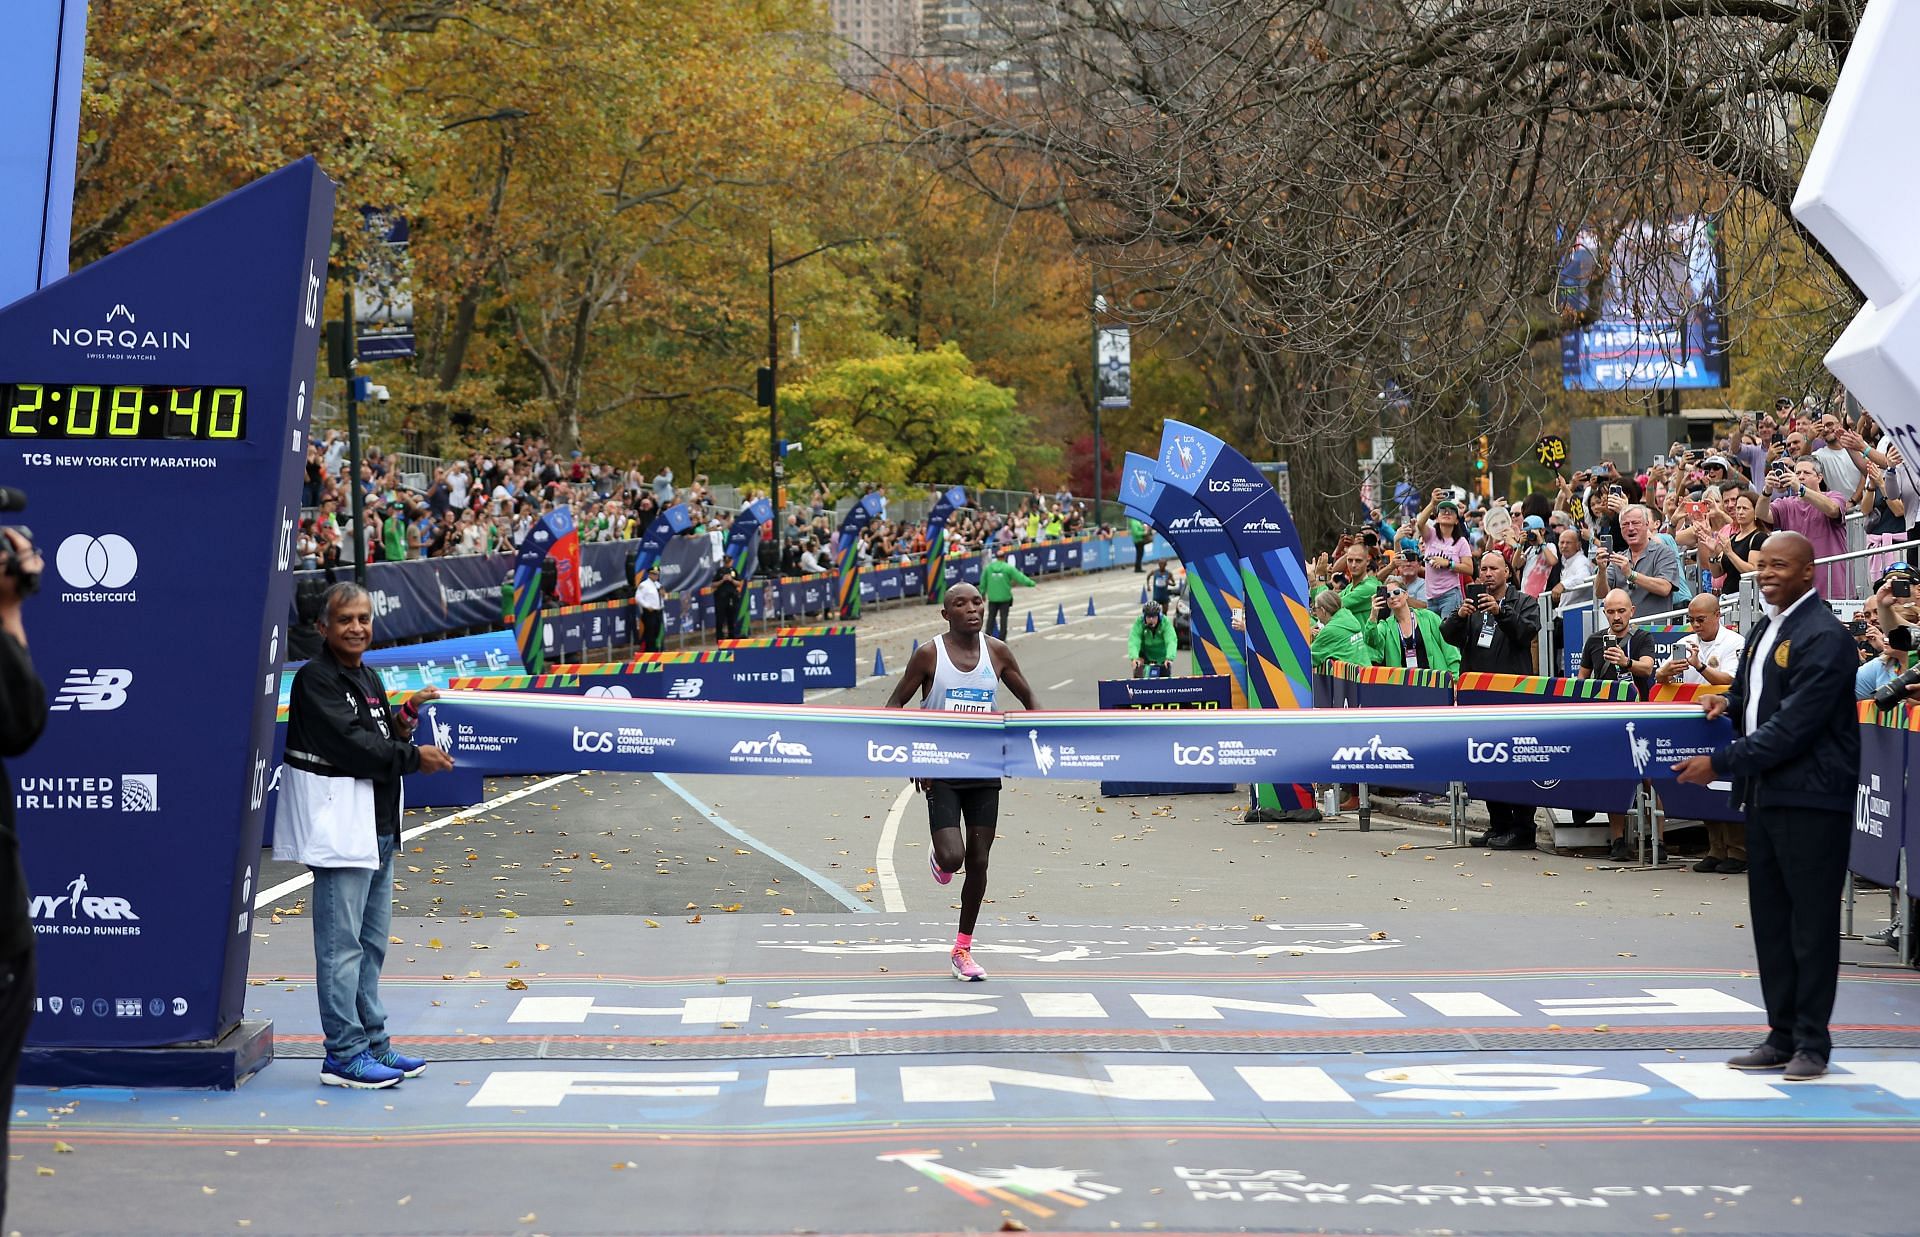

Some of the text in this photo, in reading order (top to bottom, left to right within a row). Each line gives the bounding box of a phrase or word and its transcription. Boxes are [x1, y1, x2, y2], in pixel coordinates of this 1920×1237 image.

[304, 258, 320, 329] tcs
[52, 328, 191, 350] NORQAIN
[1537, 439, 1565, 463] 大迫
[22, 453, 217, 468] TCS NEW YORK CITY MARATHON
[1209, 478, 1231, 492] tcs
[1169, 516, 1223, 529] NYRR
[62, 591, 136, 602] mastercard
[803, 667, 831, 676] TATA
[458, 724, 473, 735] tcs
[618, 727, 643, 736] TATA
[458, 734, 518, 744] NEW YORK CITY
[573, 726, 613, 753] tcs
[617, 735, 676, 747] CONSULTANCY
[1512, 736, 1539, 745] TATA
[1656, 738, 1672, 747] tcs
[458, 743, 502, 751] MARATHON
[617, 744, 655, 754] SERVICES
[731, 740, 812, 756] NYRR
[912, 742, 937, 751] TATA
[1060, 745, 1075, 755] tcs
[1218, 741, 1243, 749] TATA
[1467, 737, 1509, 763] tcs
[1512, 745, 1571, 756] CONSULTANCY
[867, 740, 909, 763] tcs
[911, 750, 970, 761] CONSULTANCY
[1173, 742, 1215, 766] tcs
[1218, 749, 1277, 757] CONSULTANCY
[1332, 746, 1415, 761] NYRR
[911, 756, 949, 765] SERVICES
[1218, 757, 1257, 765] SERVICES
[1512, 755, 1550, 763] SERVICES
[21, 777, 114, 792] UNITED
[16, 795, 114, 809] IRLINES
[32, 925, 141, 935] YORK ROAD RUNNERS
[507, 988, 1768, 1024] FINISH
[1173, 1166, 1307, 1181] tcs
[1186, 1180, 1752, 1196] NEW YORK CITY
[1193, 1191, 1609, 1208] MARATHON
